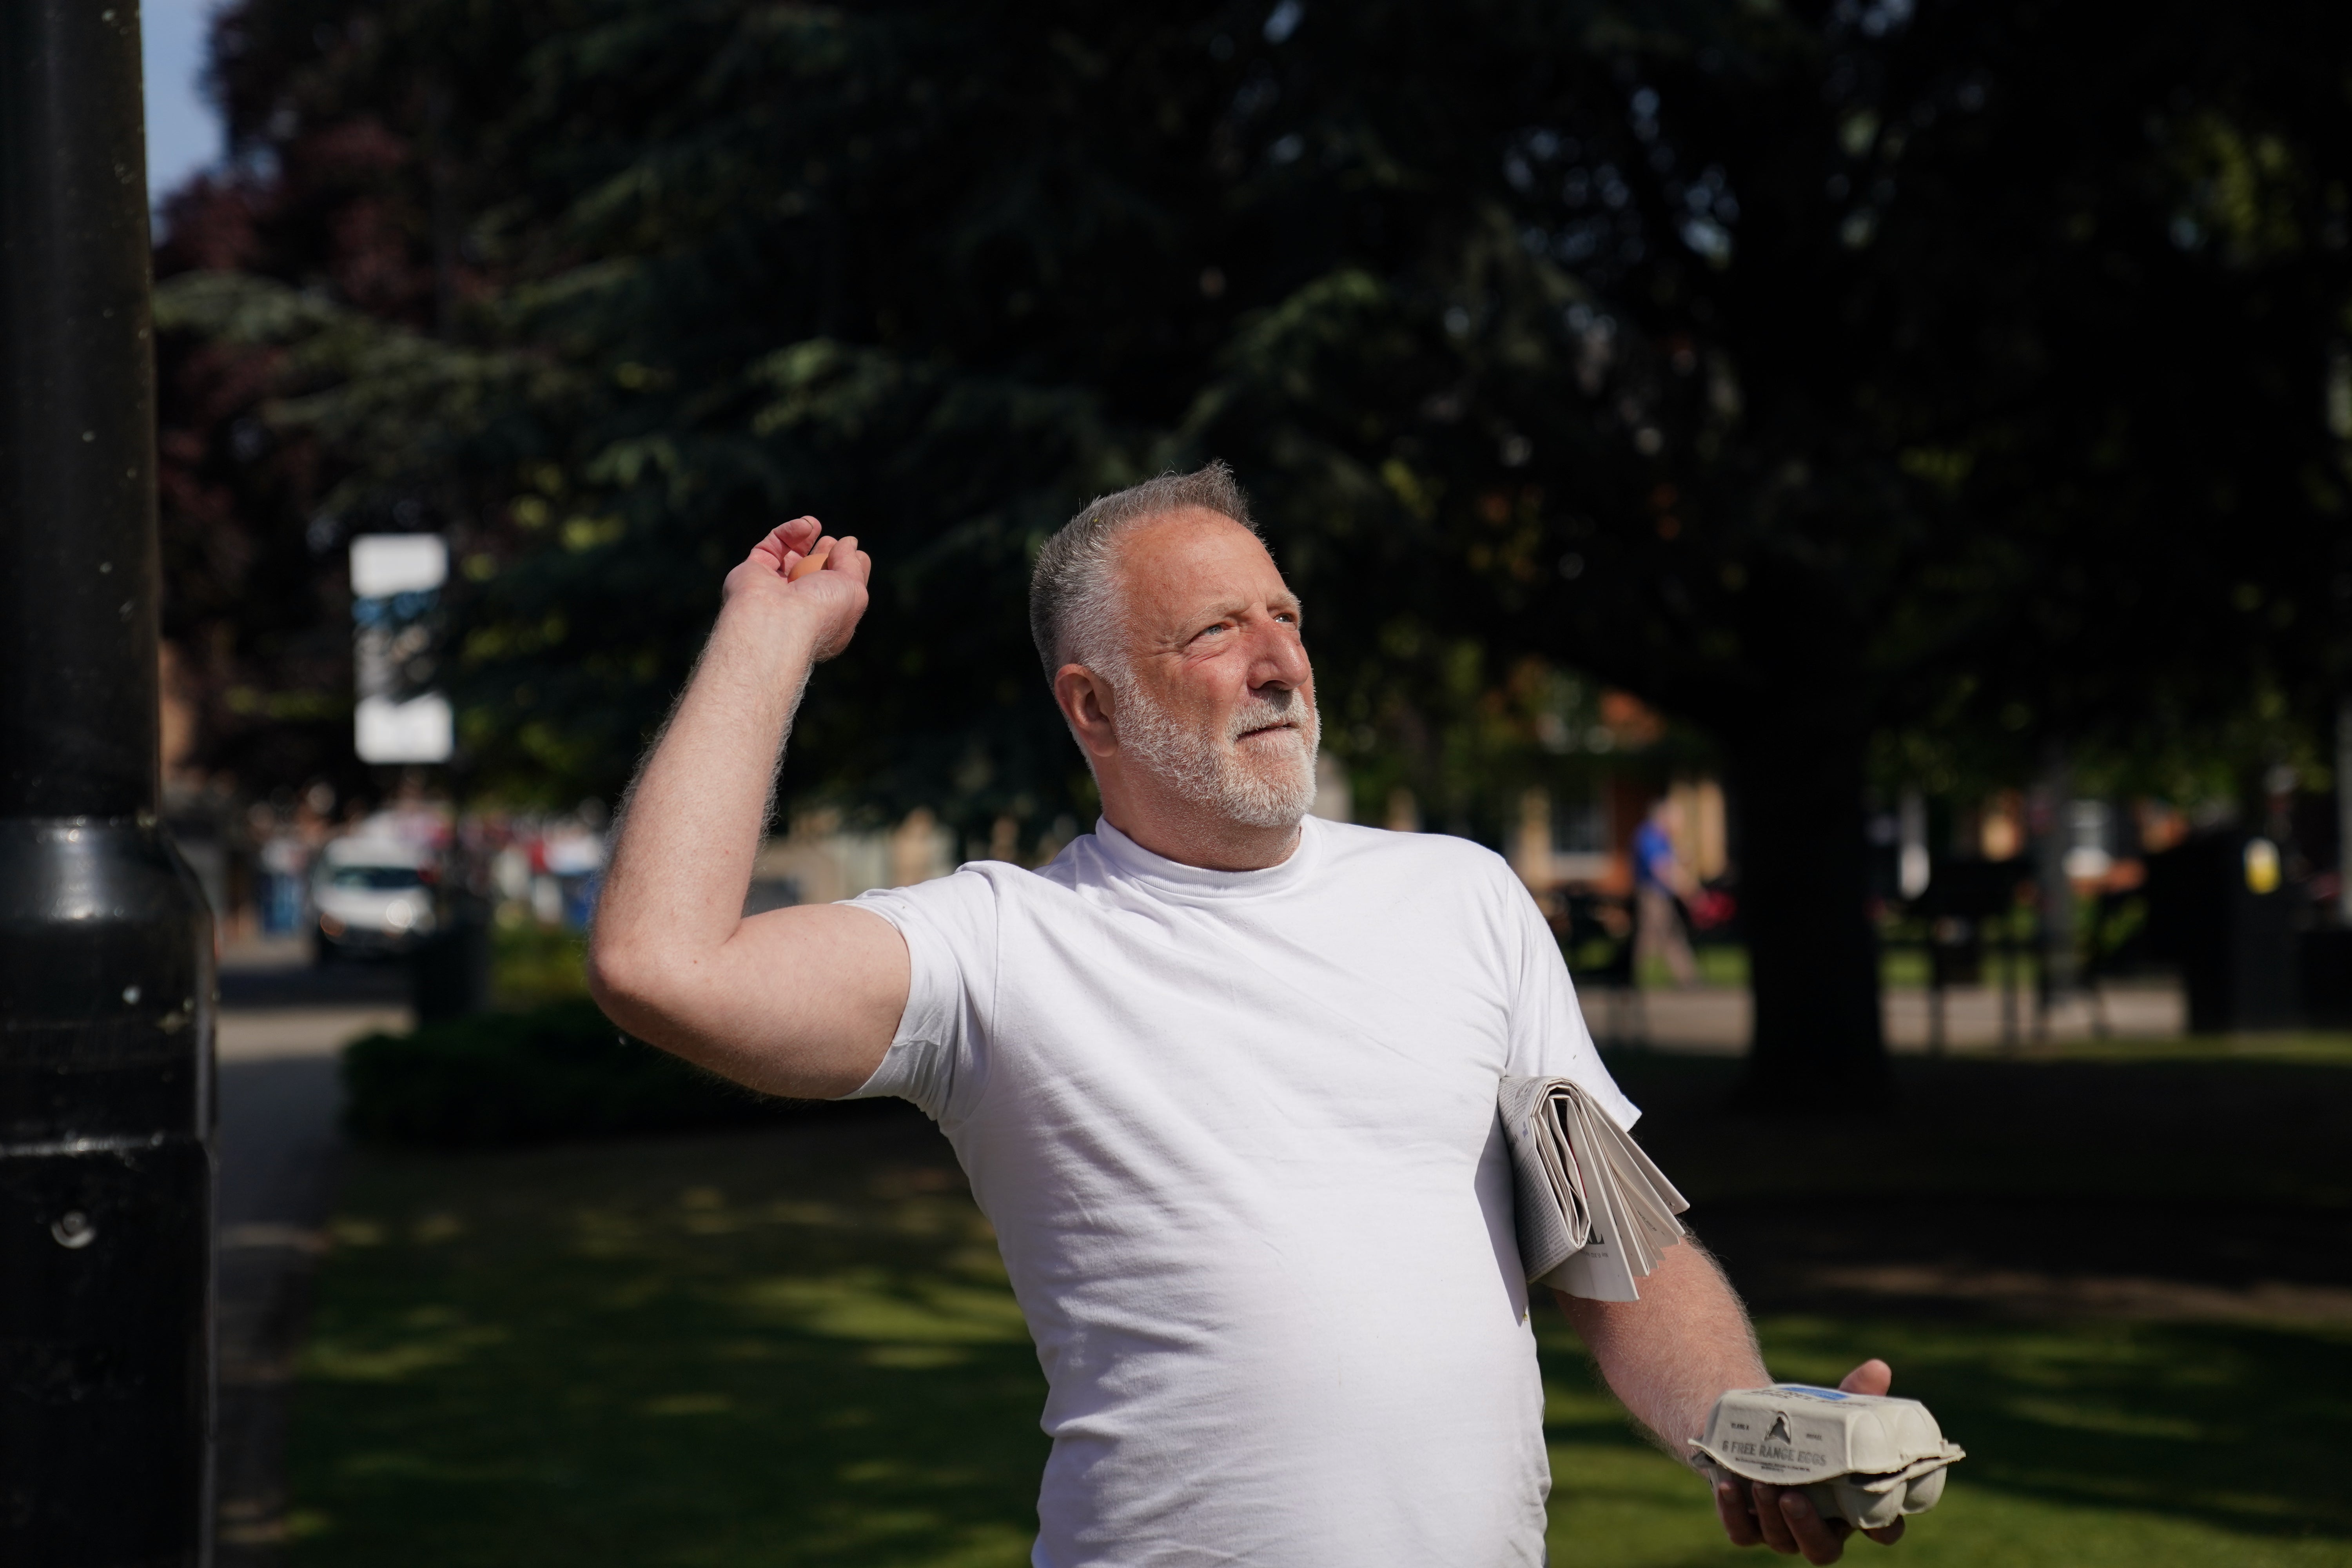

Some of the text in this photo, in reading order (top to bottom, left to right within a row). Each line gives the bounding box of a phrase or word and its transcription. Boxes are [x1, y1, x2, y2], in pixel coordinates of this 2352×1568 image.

[1722, 1441, 1729, 1452] 6
[1731, 1442, 1757, 1455] FREE
[1759, 1444, 1796, 1462] RANGE
[1797, 1451, 1827, 1466] EGGS
